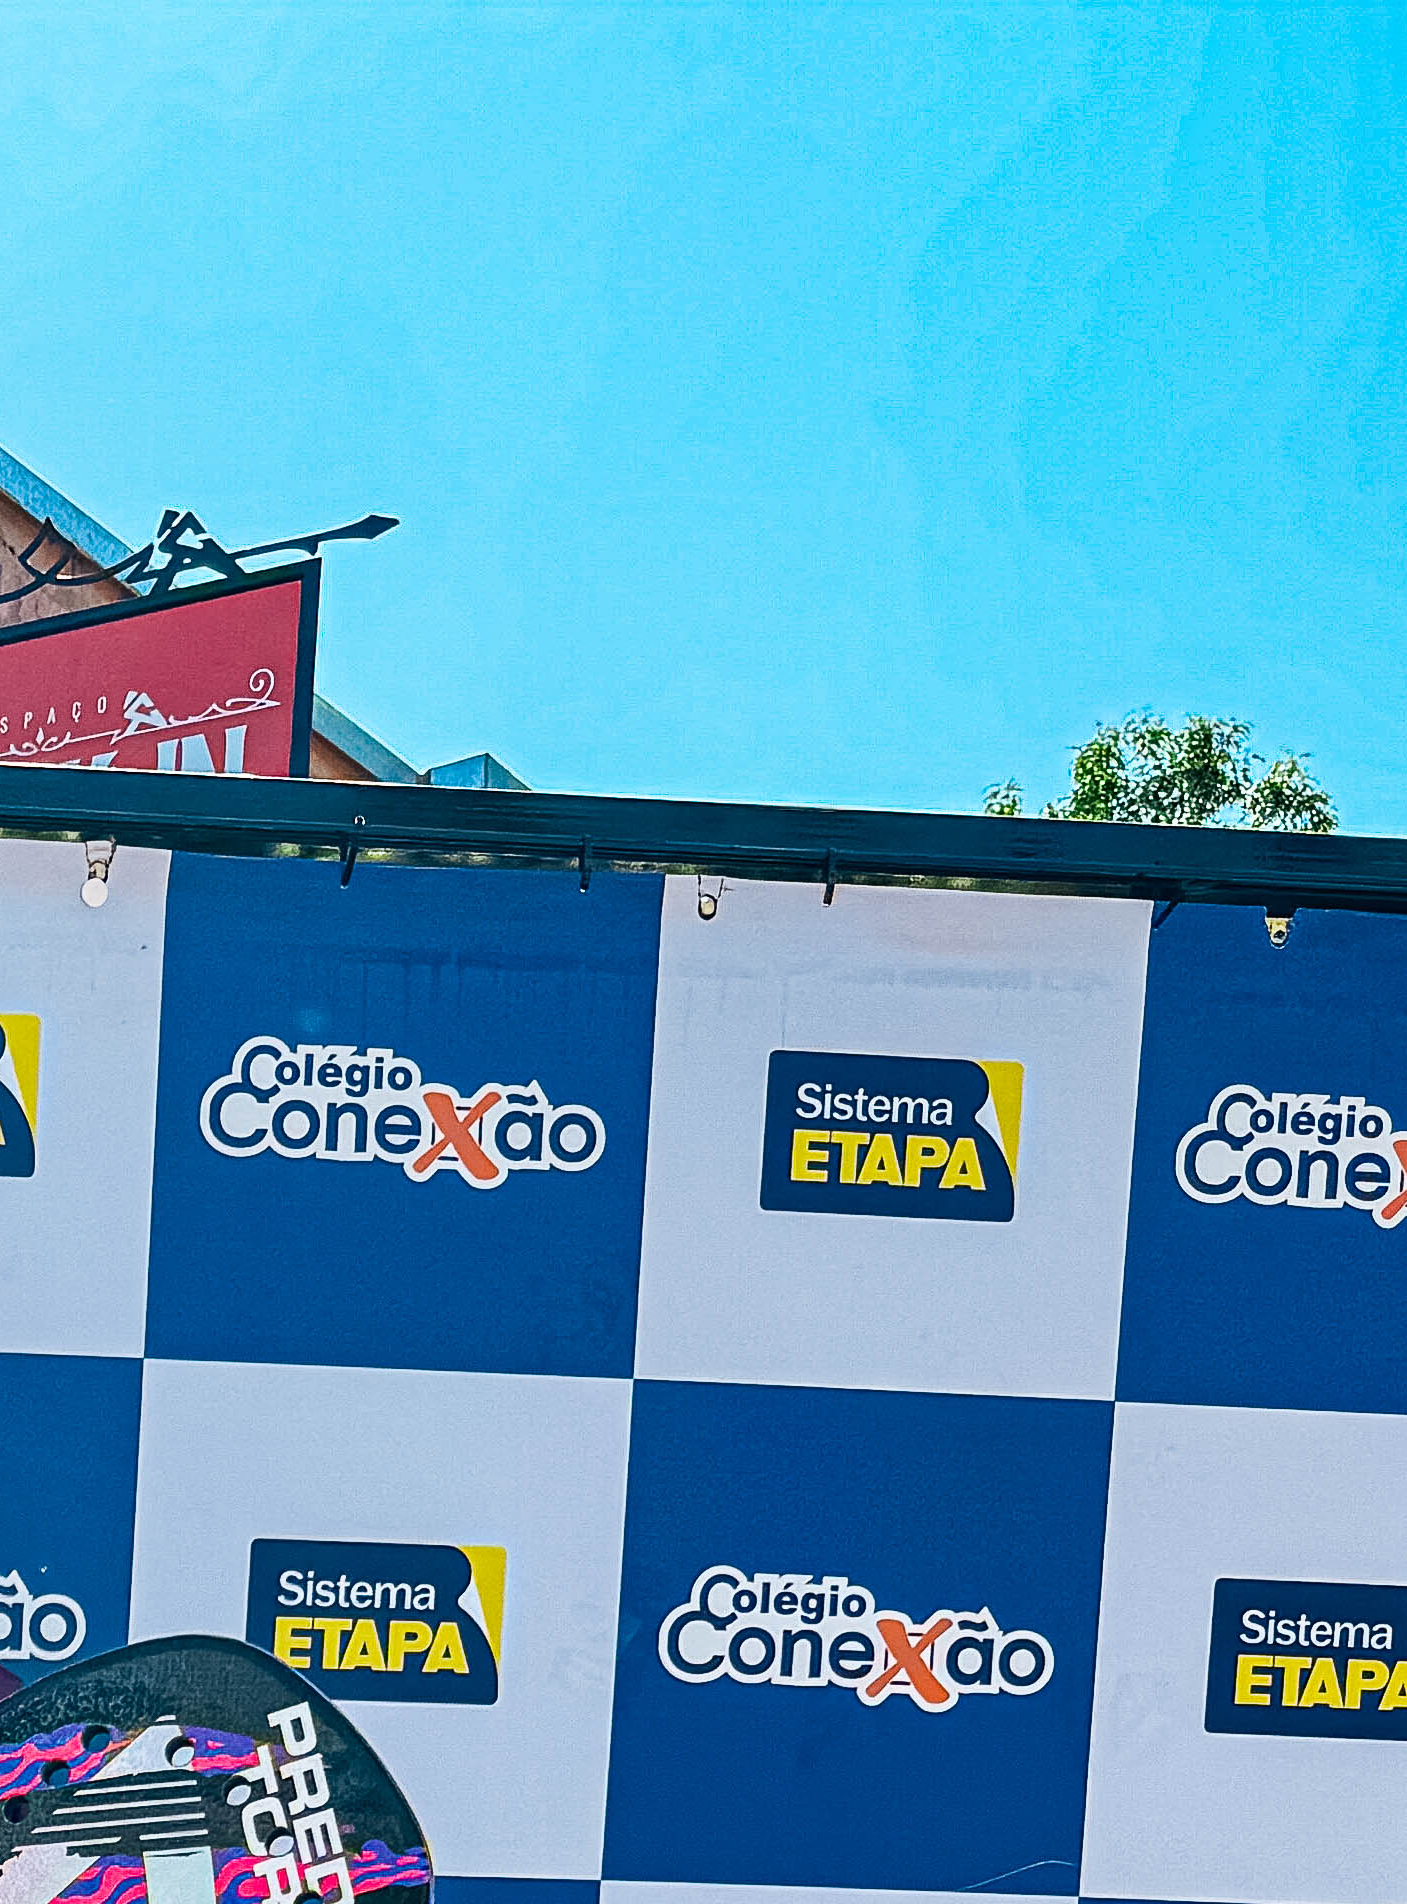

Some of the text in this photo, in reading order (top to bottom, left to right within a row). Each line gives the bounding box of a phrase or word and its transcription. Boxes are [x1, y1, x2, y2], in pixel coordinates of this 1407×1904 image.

[241, 1041, 415, 1098] Colégio
[796, 1082, 954, 1128] Sistema
[1216, 1091, 1387, 1143] Colégio
[789, 1132, 986, 1189] ETAPA
[277, 1571, 436, 1611] Sistema
[696, 1569, 869, 1623] Colégio
[273, 1619, 469, 1672] ETAPA
[1239, 1610, 1393, 1649] Sistema
